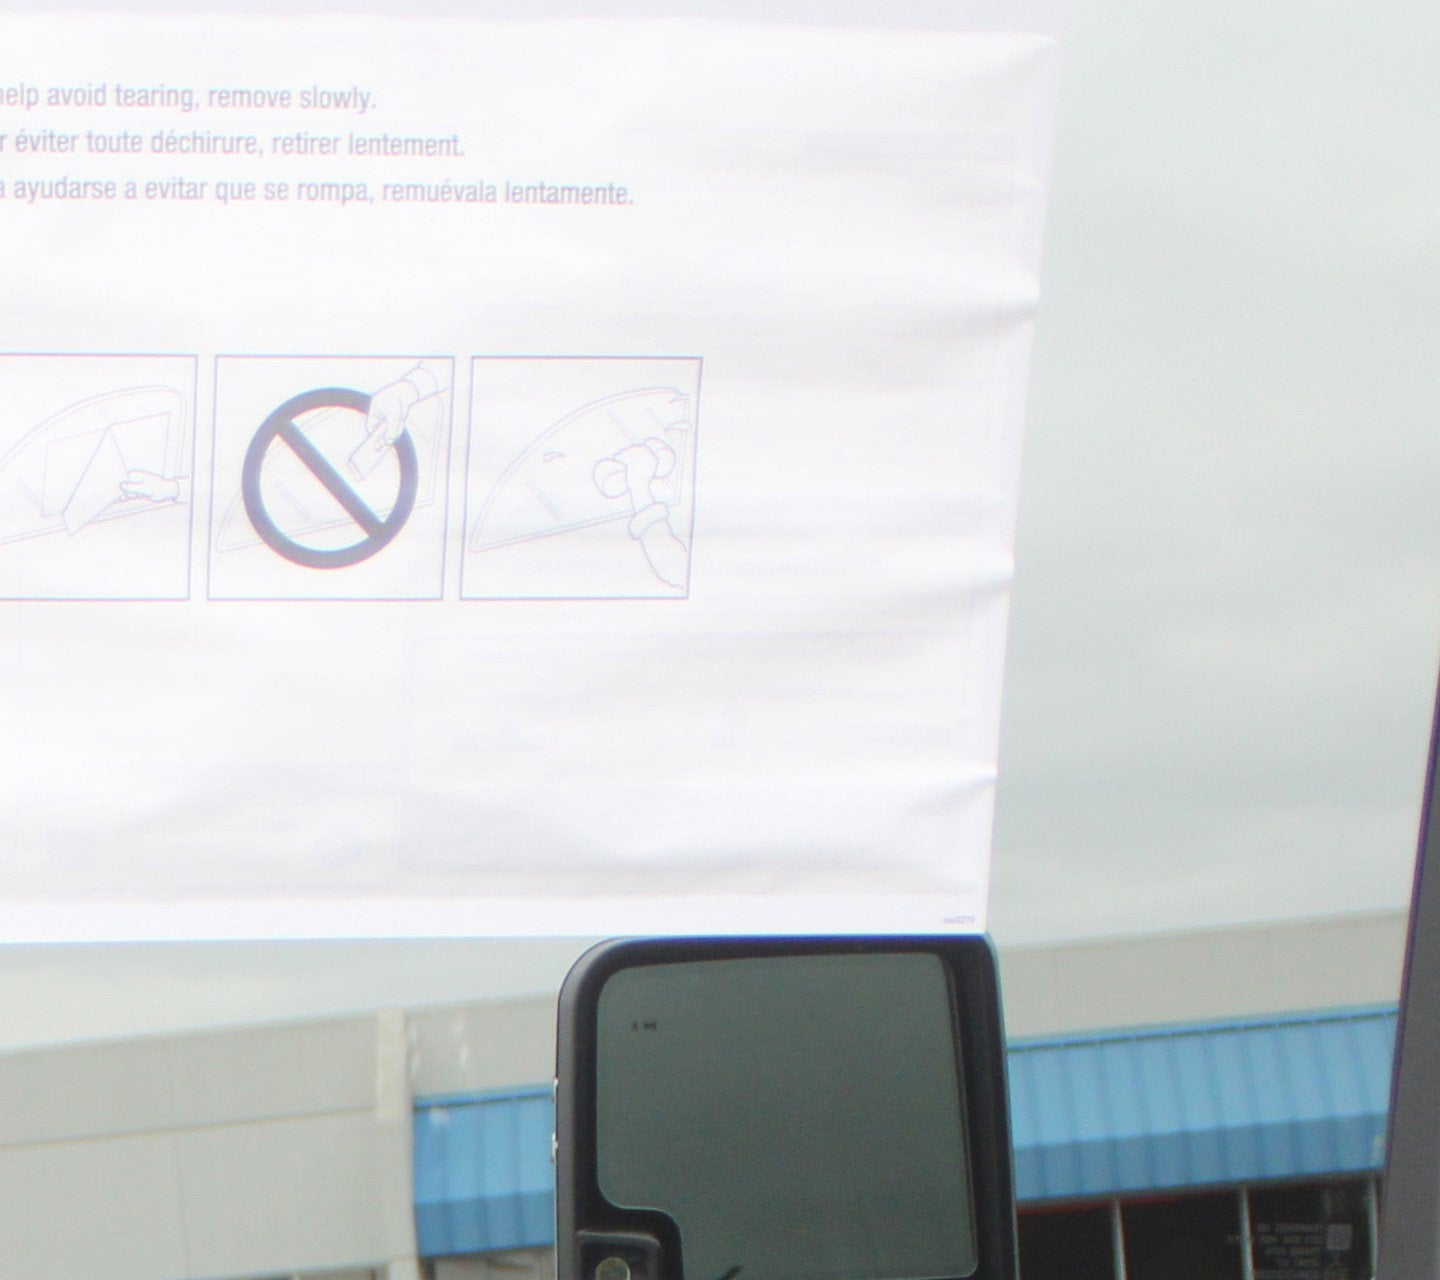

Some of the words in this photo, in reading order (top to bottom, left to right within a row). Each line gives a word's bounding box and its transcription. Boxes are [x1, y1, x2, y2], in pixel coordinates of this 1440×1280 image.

[46, 84, 108, 107] avoid
[115, 85, 200, 112] tearing,
[207, 89, 293, 109] remove
[299, 86, 377, 115] slowly.
[14, 128, 79, 153] éviter
[87, 131, 144, 153] toute
[150, 129, 264, 157] déchirure,
[272, 132, 342, 154] retirer
[348, 133, 466, 157] lentement.
[13, 176, 117, 204] ayudarse
[124, 184, 138, 200] a
[145, 177, 208, 200] evitar
[214, 183, 258, 206] que
[264, 183, 289, 201] se
[296, 182, 375, 206] rompa,
[382, 180, 498, 203] remuévala
[504, 181, 635, 205] lentamente.
